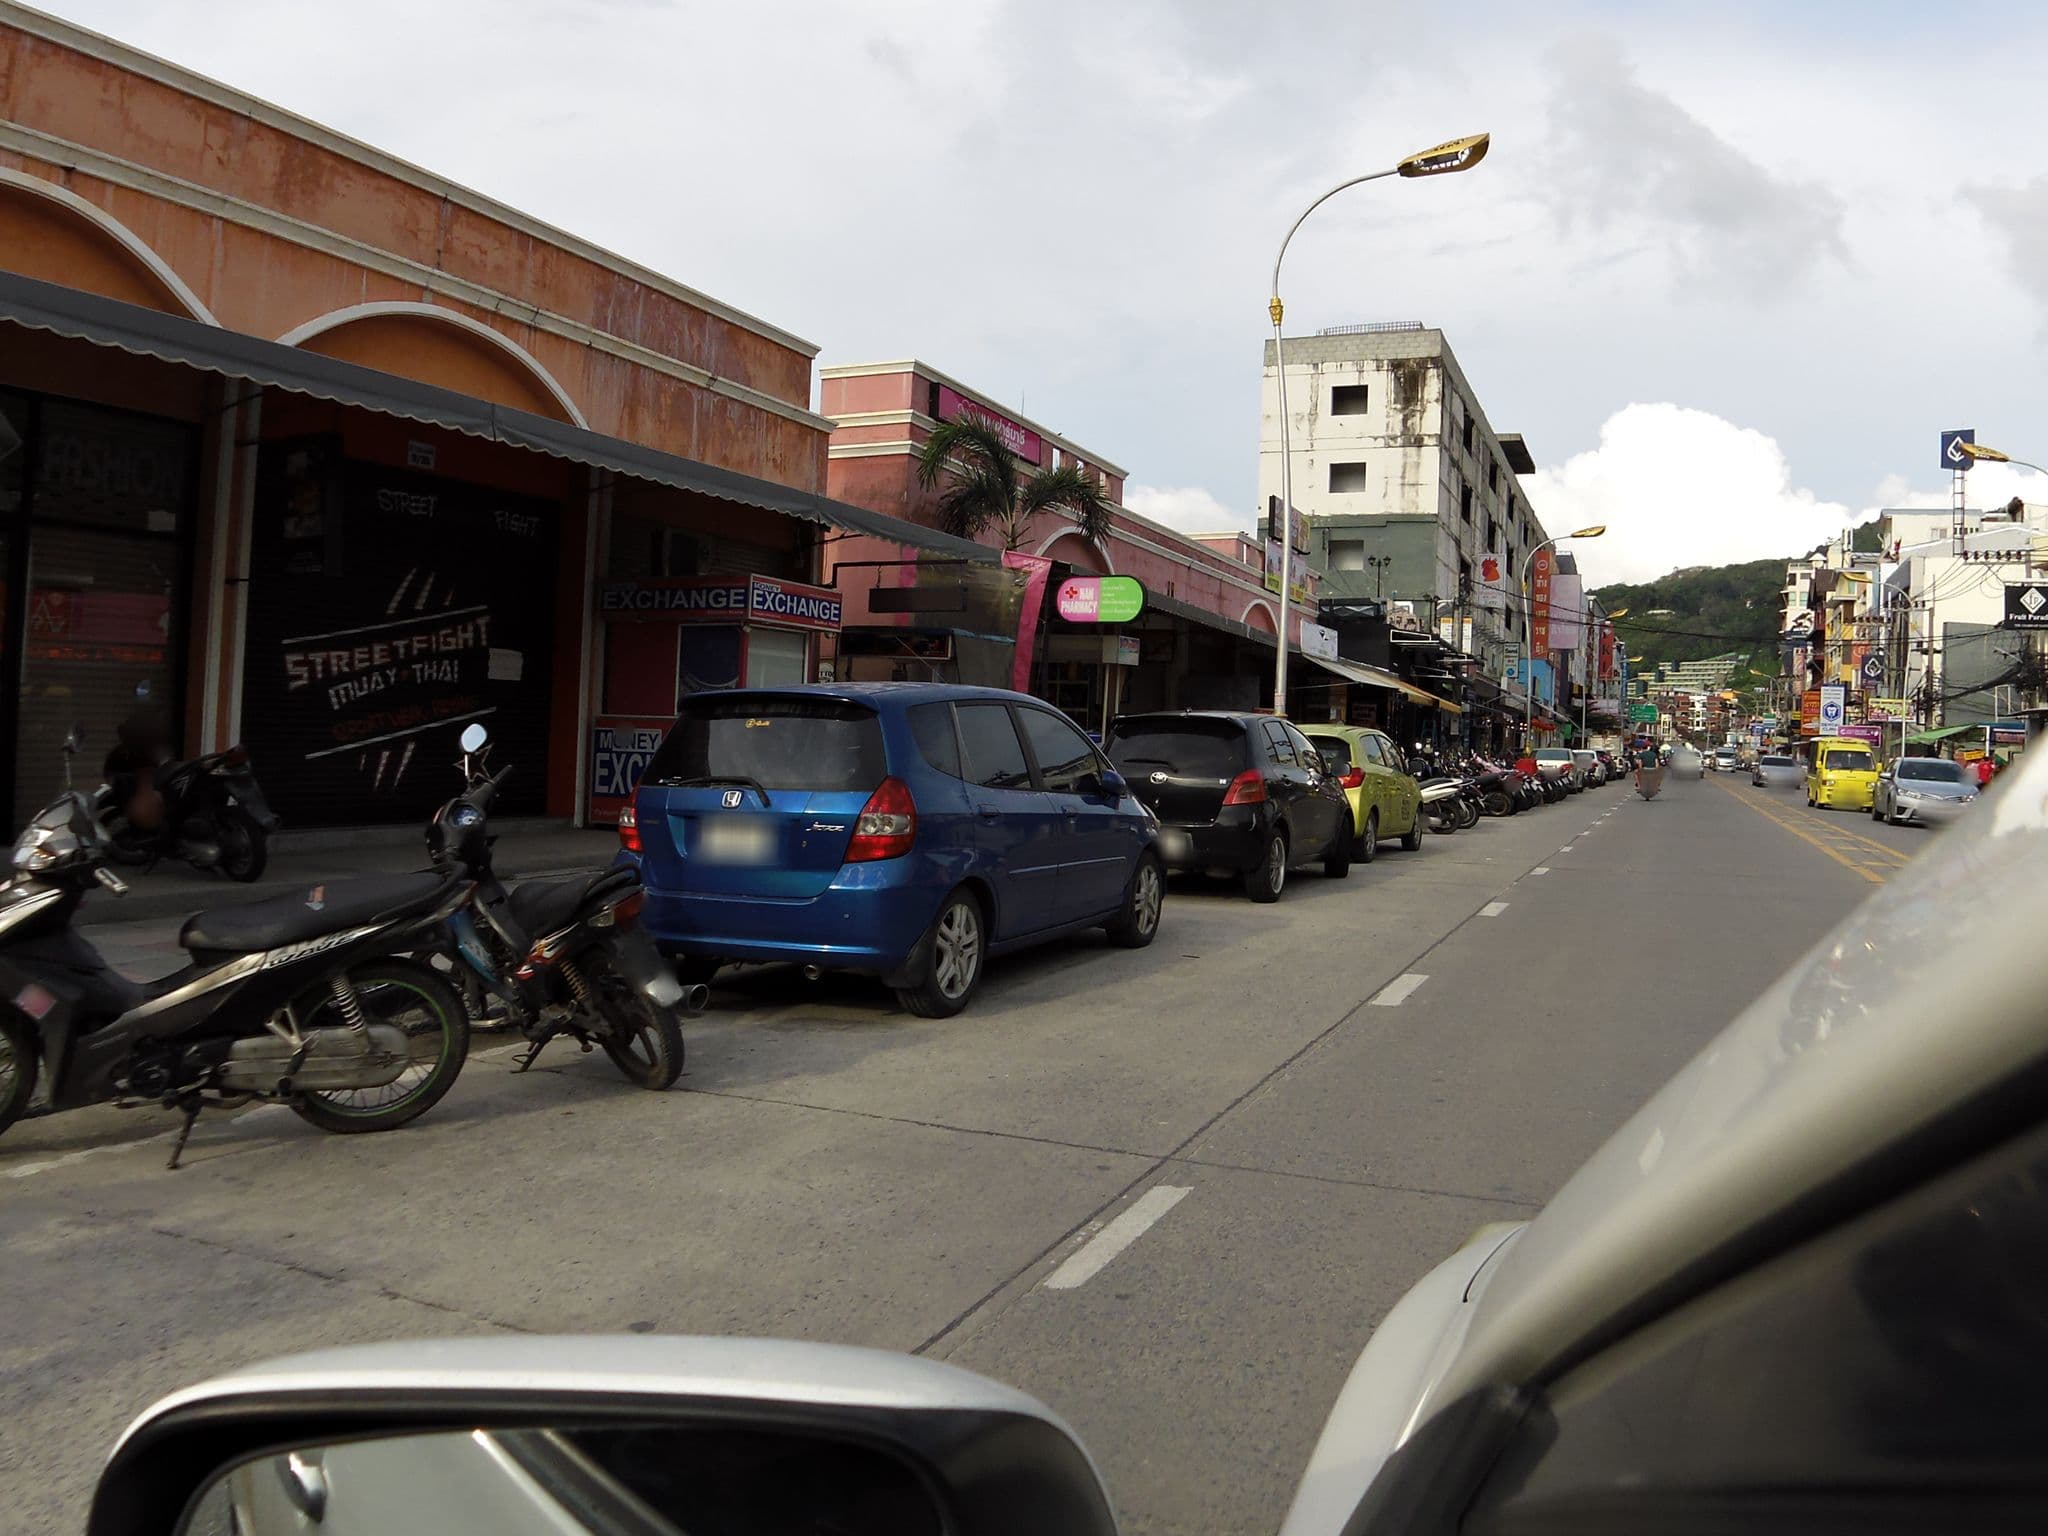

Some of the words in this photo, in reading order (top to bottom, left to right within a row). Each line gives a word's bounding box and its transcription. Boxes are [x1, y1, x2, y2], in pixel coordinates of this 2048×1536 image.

[378, 488, 440, 520] STREET
[495, 510, 543, 537] FIGHT
[603, 588, 746, 609] EXCHANGE
[752, 589, 840, 622] EXCHANGE
[328, 668, 398, 711] MUAY
[411, 659, 460, 685] THAI
